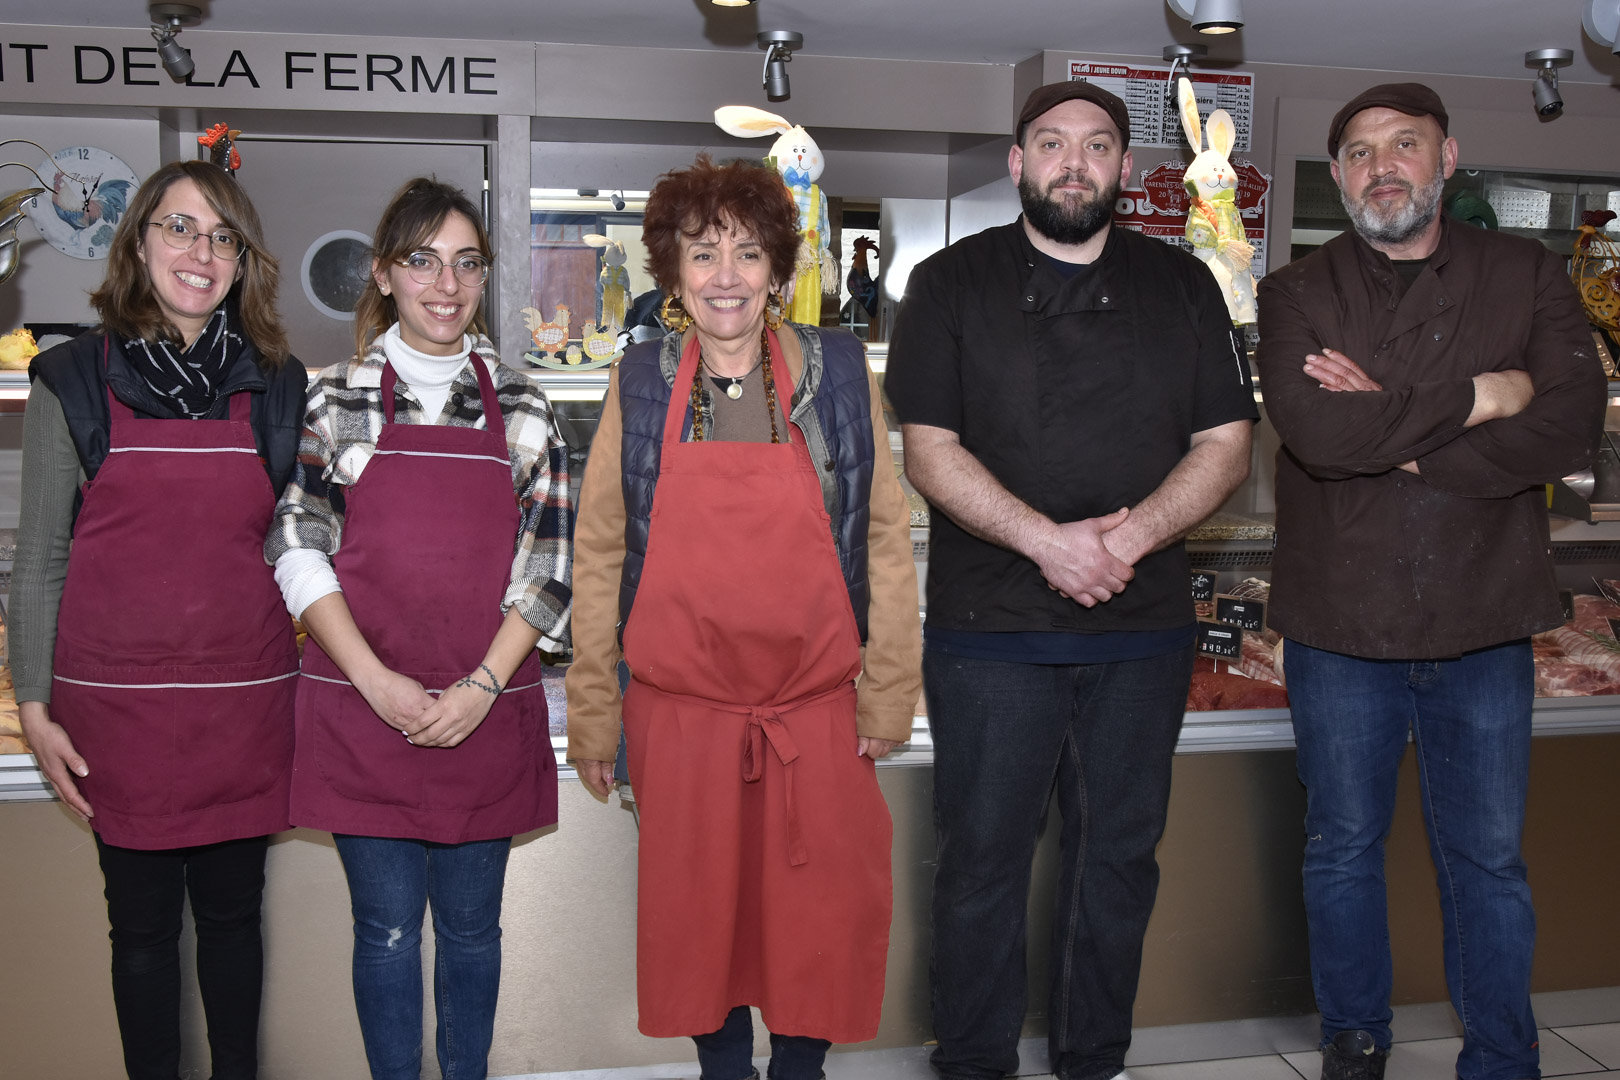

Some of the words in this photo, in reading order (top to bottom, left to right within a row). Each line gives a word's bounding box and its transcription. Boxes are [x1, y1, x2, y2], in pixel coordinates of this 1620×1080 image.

[74, 45, 160, 86] DE
[185, 48, 260, 88] LA
[285, 51, 498, 95] FERME
[78, 148, 89, 160] 12
[31, 197, 37, 208] 9
[88, 246, 94, 258] 6
